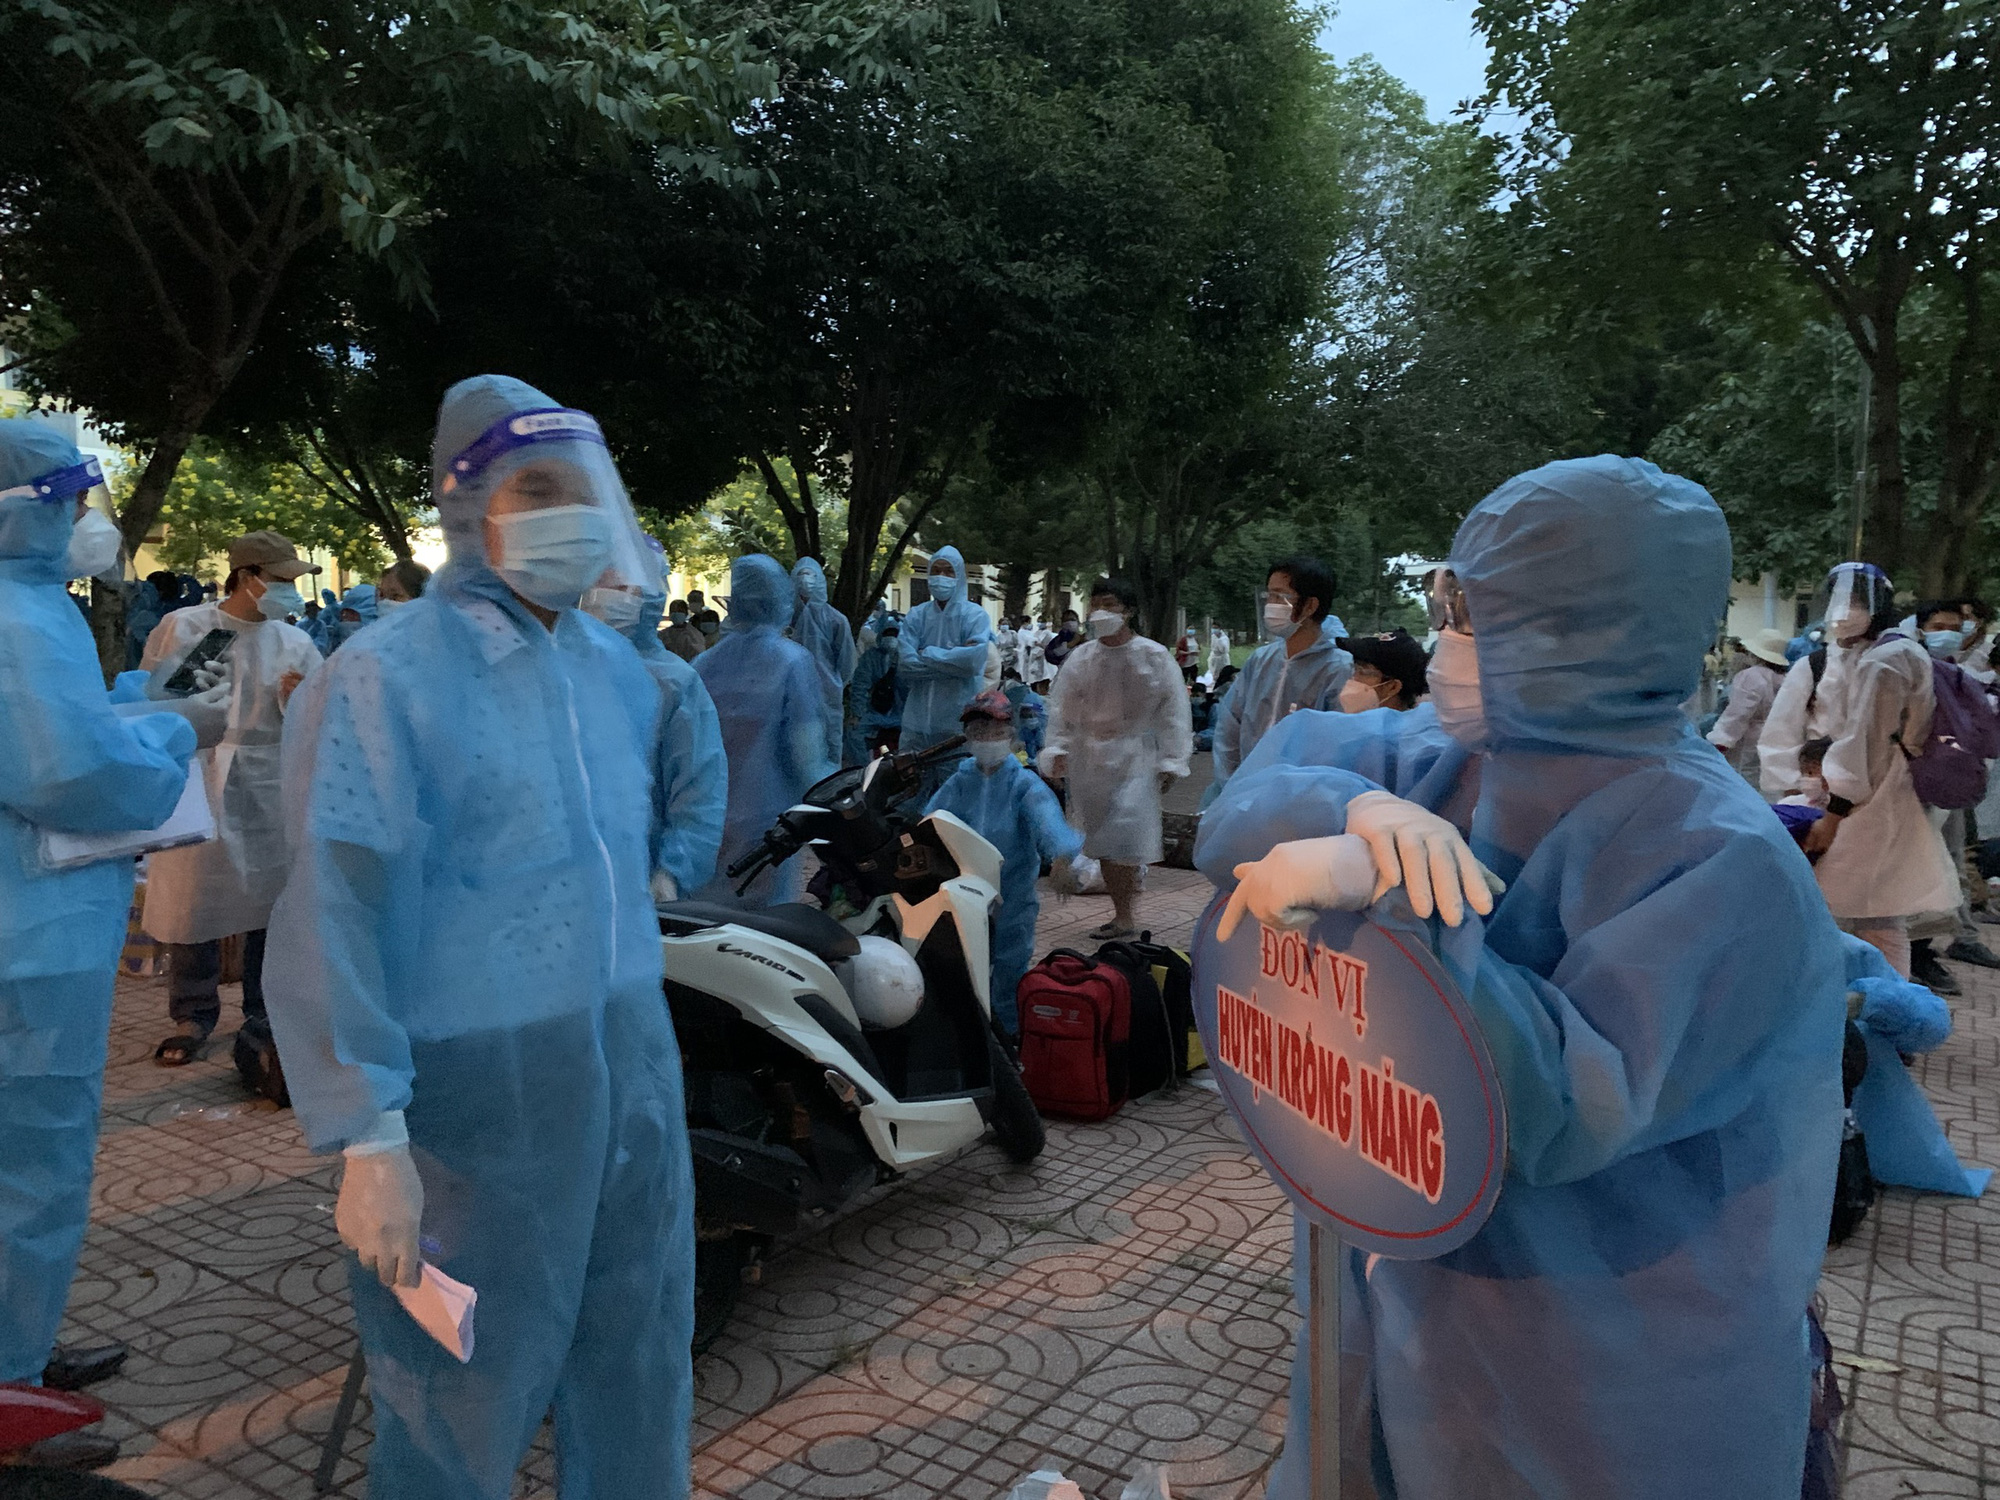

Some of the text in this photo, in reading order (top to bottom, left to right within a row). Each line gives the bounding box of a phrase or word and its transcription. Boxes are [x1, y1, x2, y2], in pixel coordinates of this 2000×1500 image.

[717, 942, 787, 968] VARIO
[1262, 926, 1366, 1036] ĐƠN VỊ
[1219, 989, 1442, 1198] HUYỆN KRÔNG NĂNG
